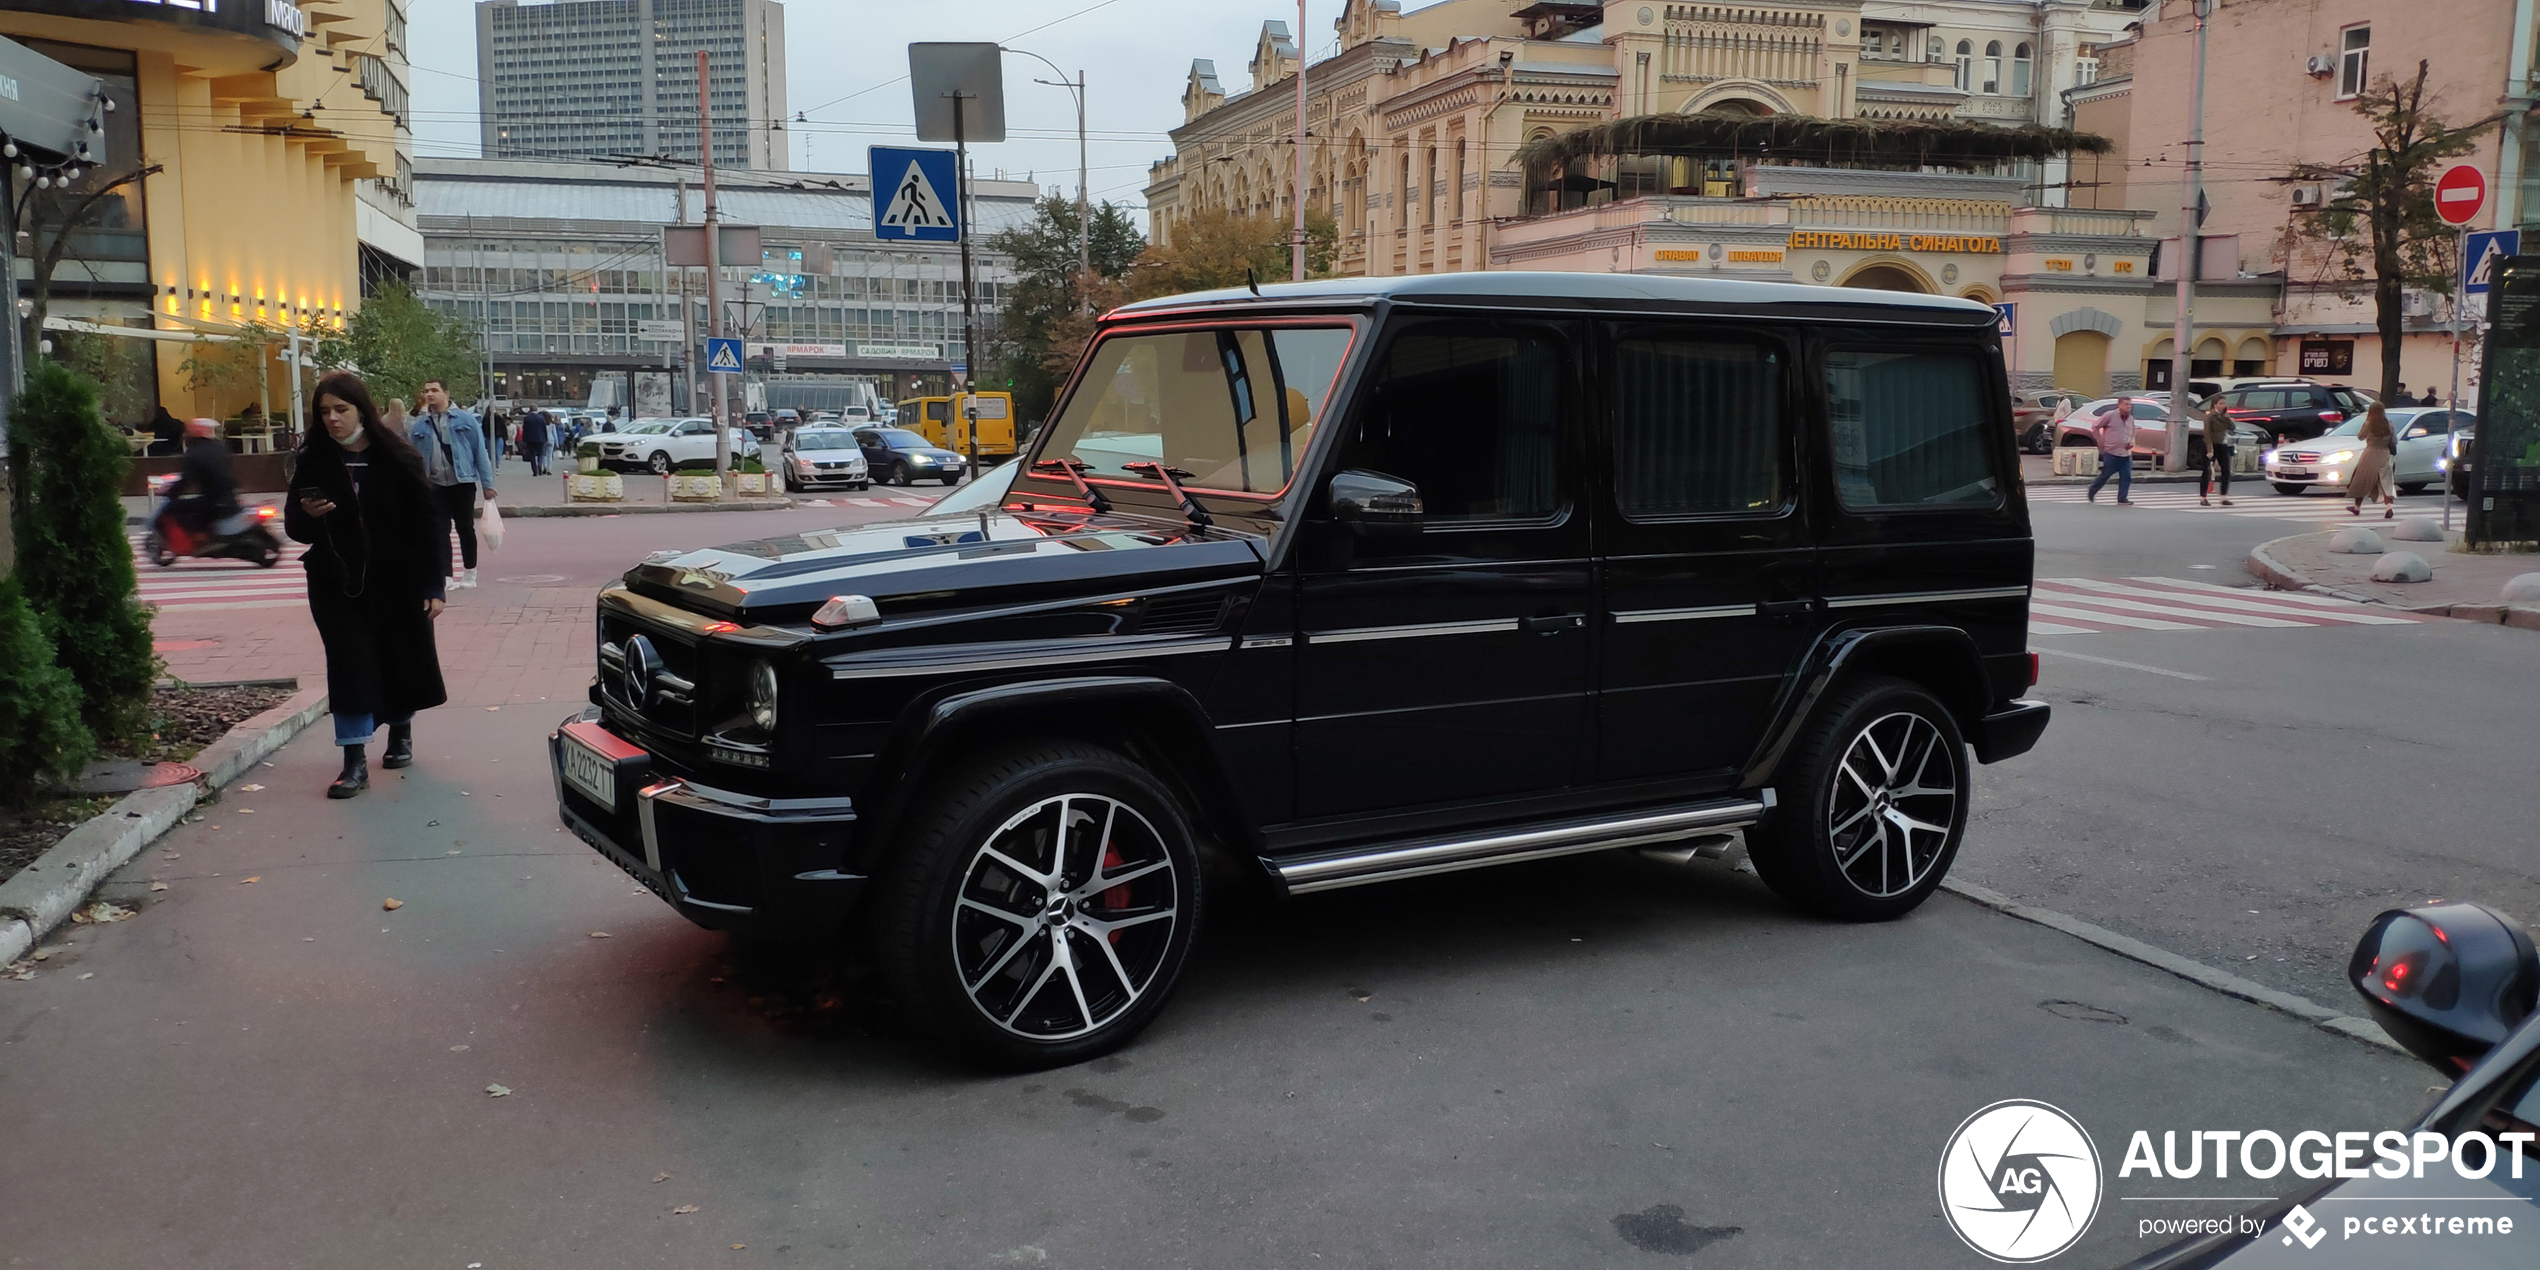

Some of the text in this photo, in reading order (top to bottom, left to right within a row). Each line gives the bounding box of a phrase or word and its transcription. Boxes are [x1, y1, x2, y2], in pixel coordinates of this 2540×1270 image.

[1909, 235, 2001, 253] СИНАГОГА
[786, 346, 824, 354] ЯРМАРОК
[860, 347, 896, 355] САДОВИЙ
